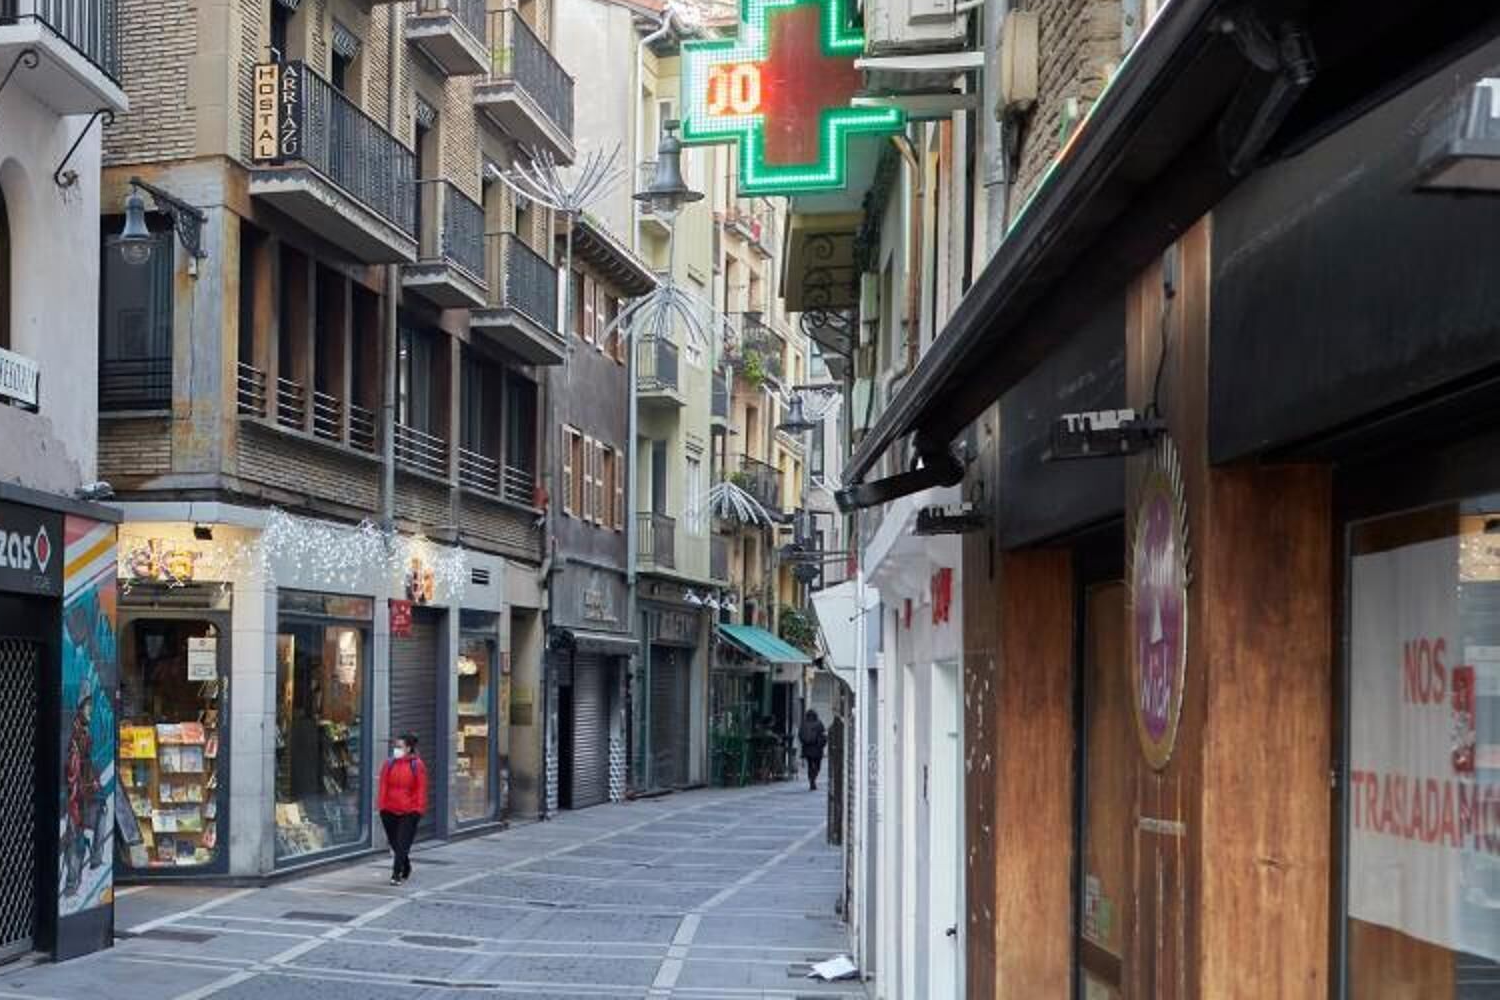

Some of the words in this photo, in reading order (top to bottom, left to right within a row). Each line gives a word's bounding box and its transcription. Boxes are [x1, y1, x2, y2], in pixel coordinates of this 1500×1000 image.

[260, 68, 275, 157] HOSTAL
[281, 65, 299, 155] ARRIAZU
[1403, 638, 1447, 705] NOS
